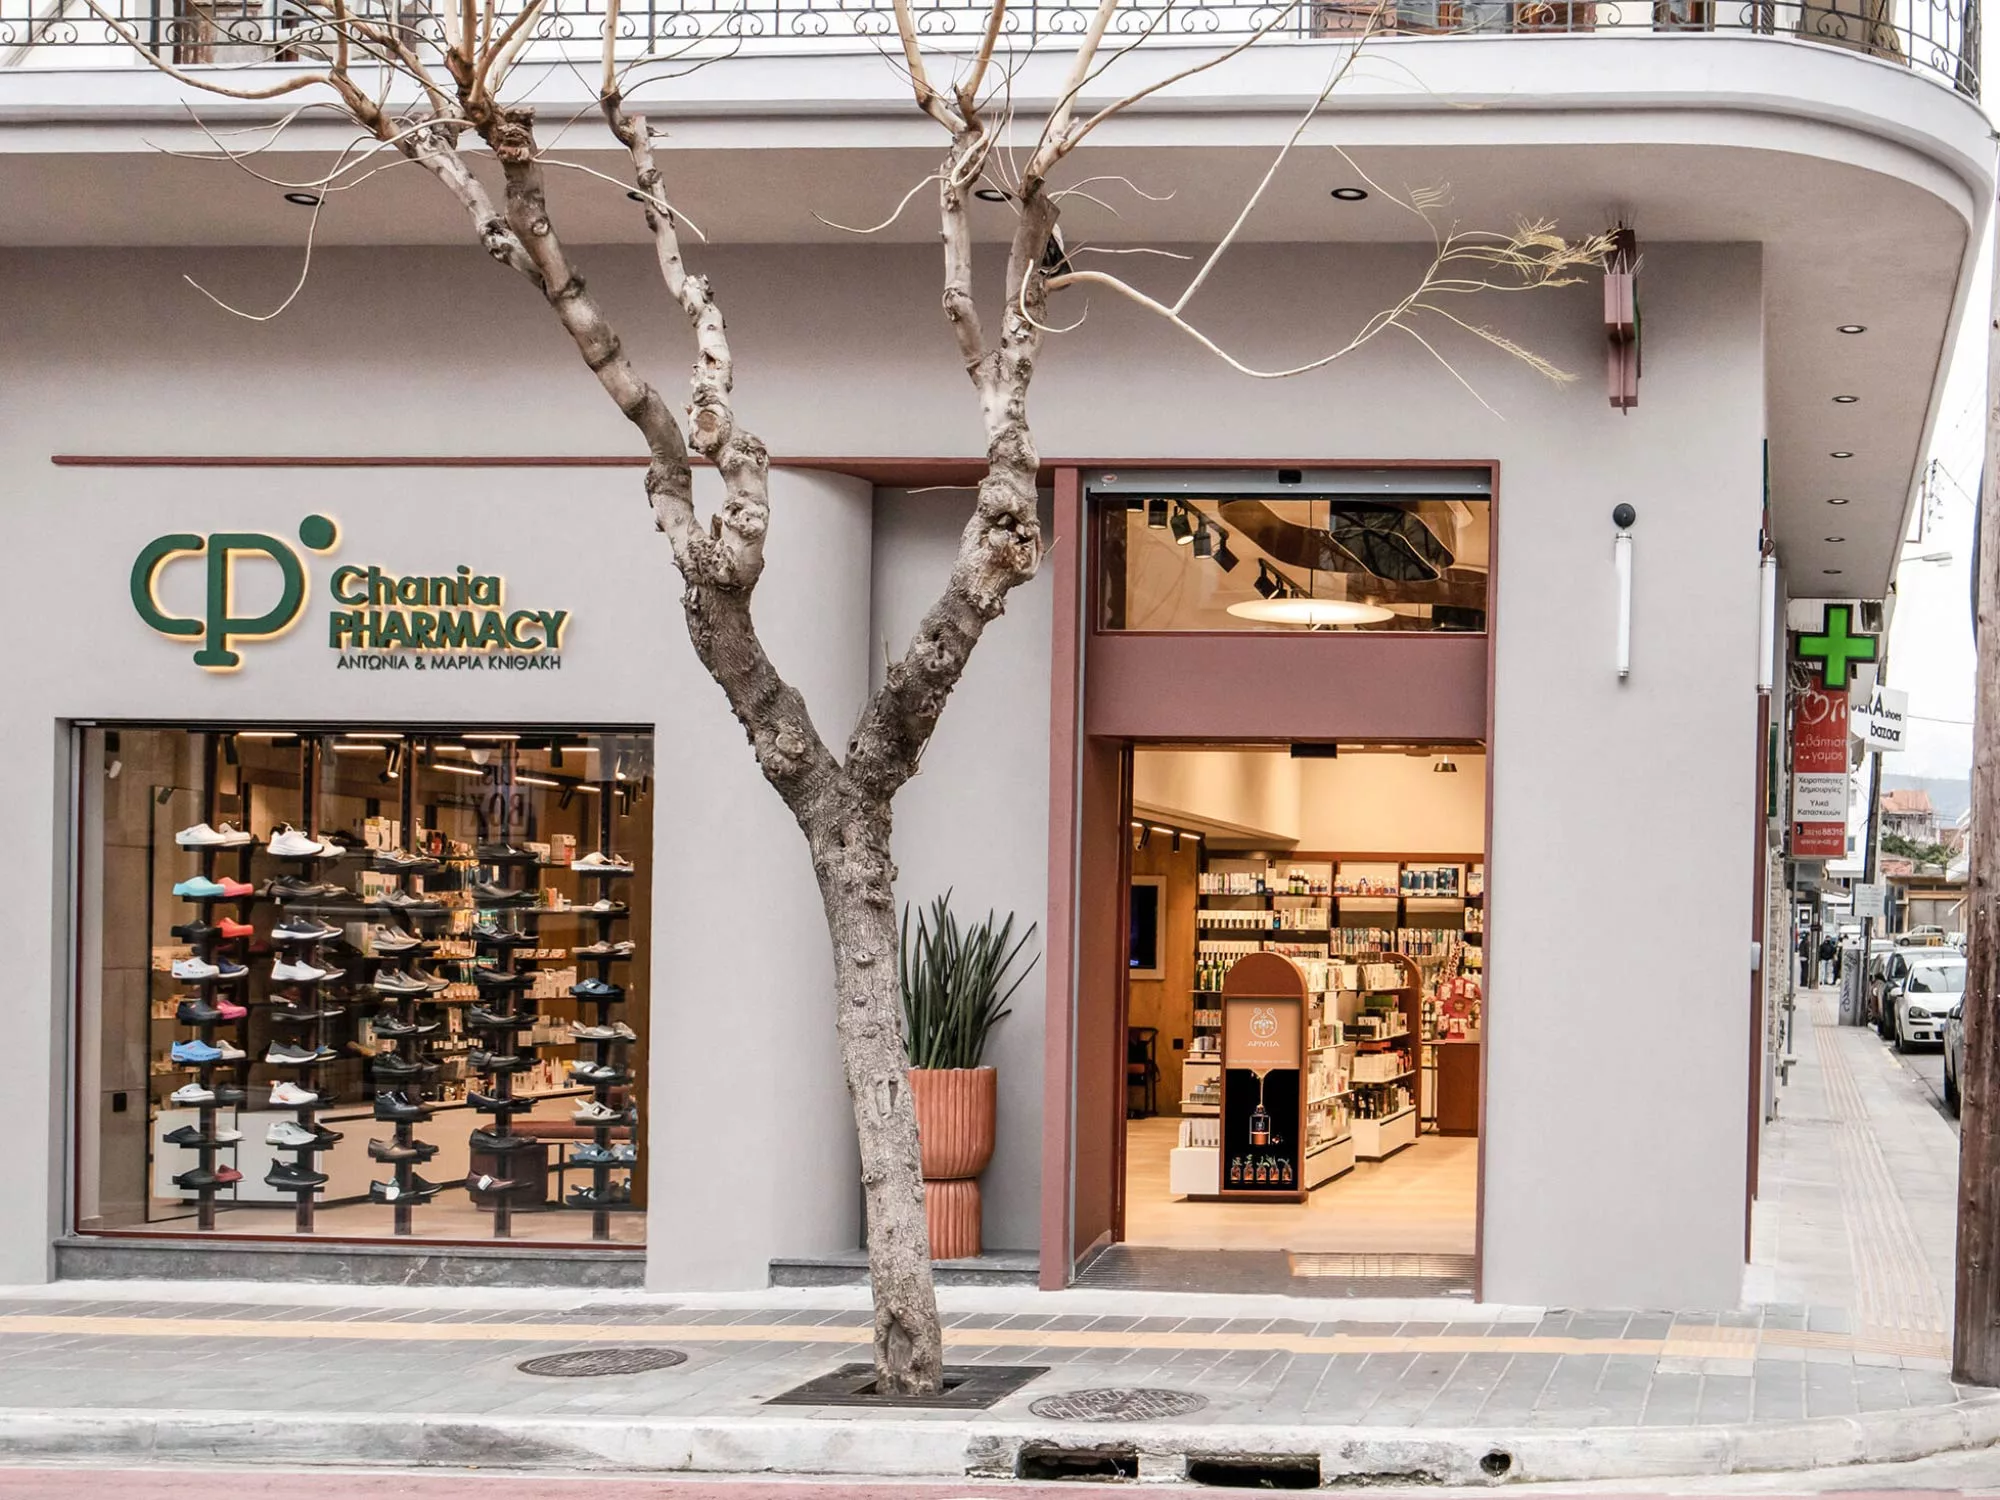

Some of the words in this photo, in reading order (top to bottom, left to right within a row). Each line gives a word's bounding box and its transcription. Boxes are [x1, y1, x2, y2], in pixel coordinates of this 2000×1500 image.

[330, 564, 501, 606] Chania
[329, 609, 569, 650] PHARMACY
[337, 655, 410, 671] ΑΝΤΩΝΙΑ
[414, 655, 426, 671] &
[430, 655, 484, 671] ΜΑΡΙΑ
[488, 655, 561, 671] ΚΝΙΘΑΚΗ
[1885, 709, 1902, 721] shoes
